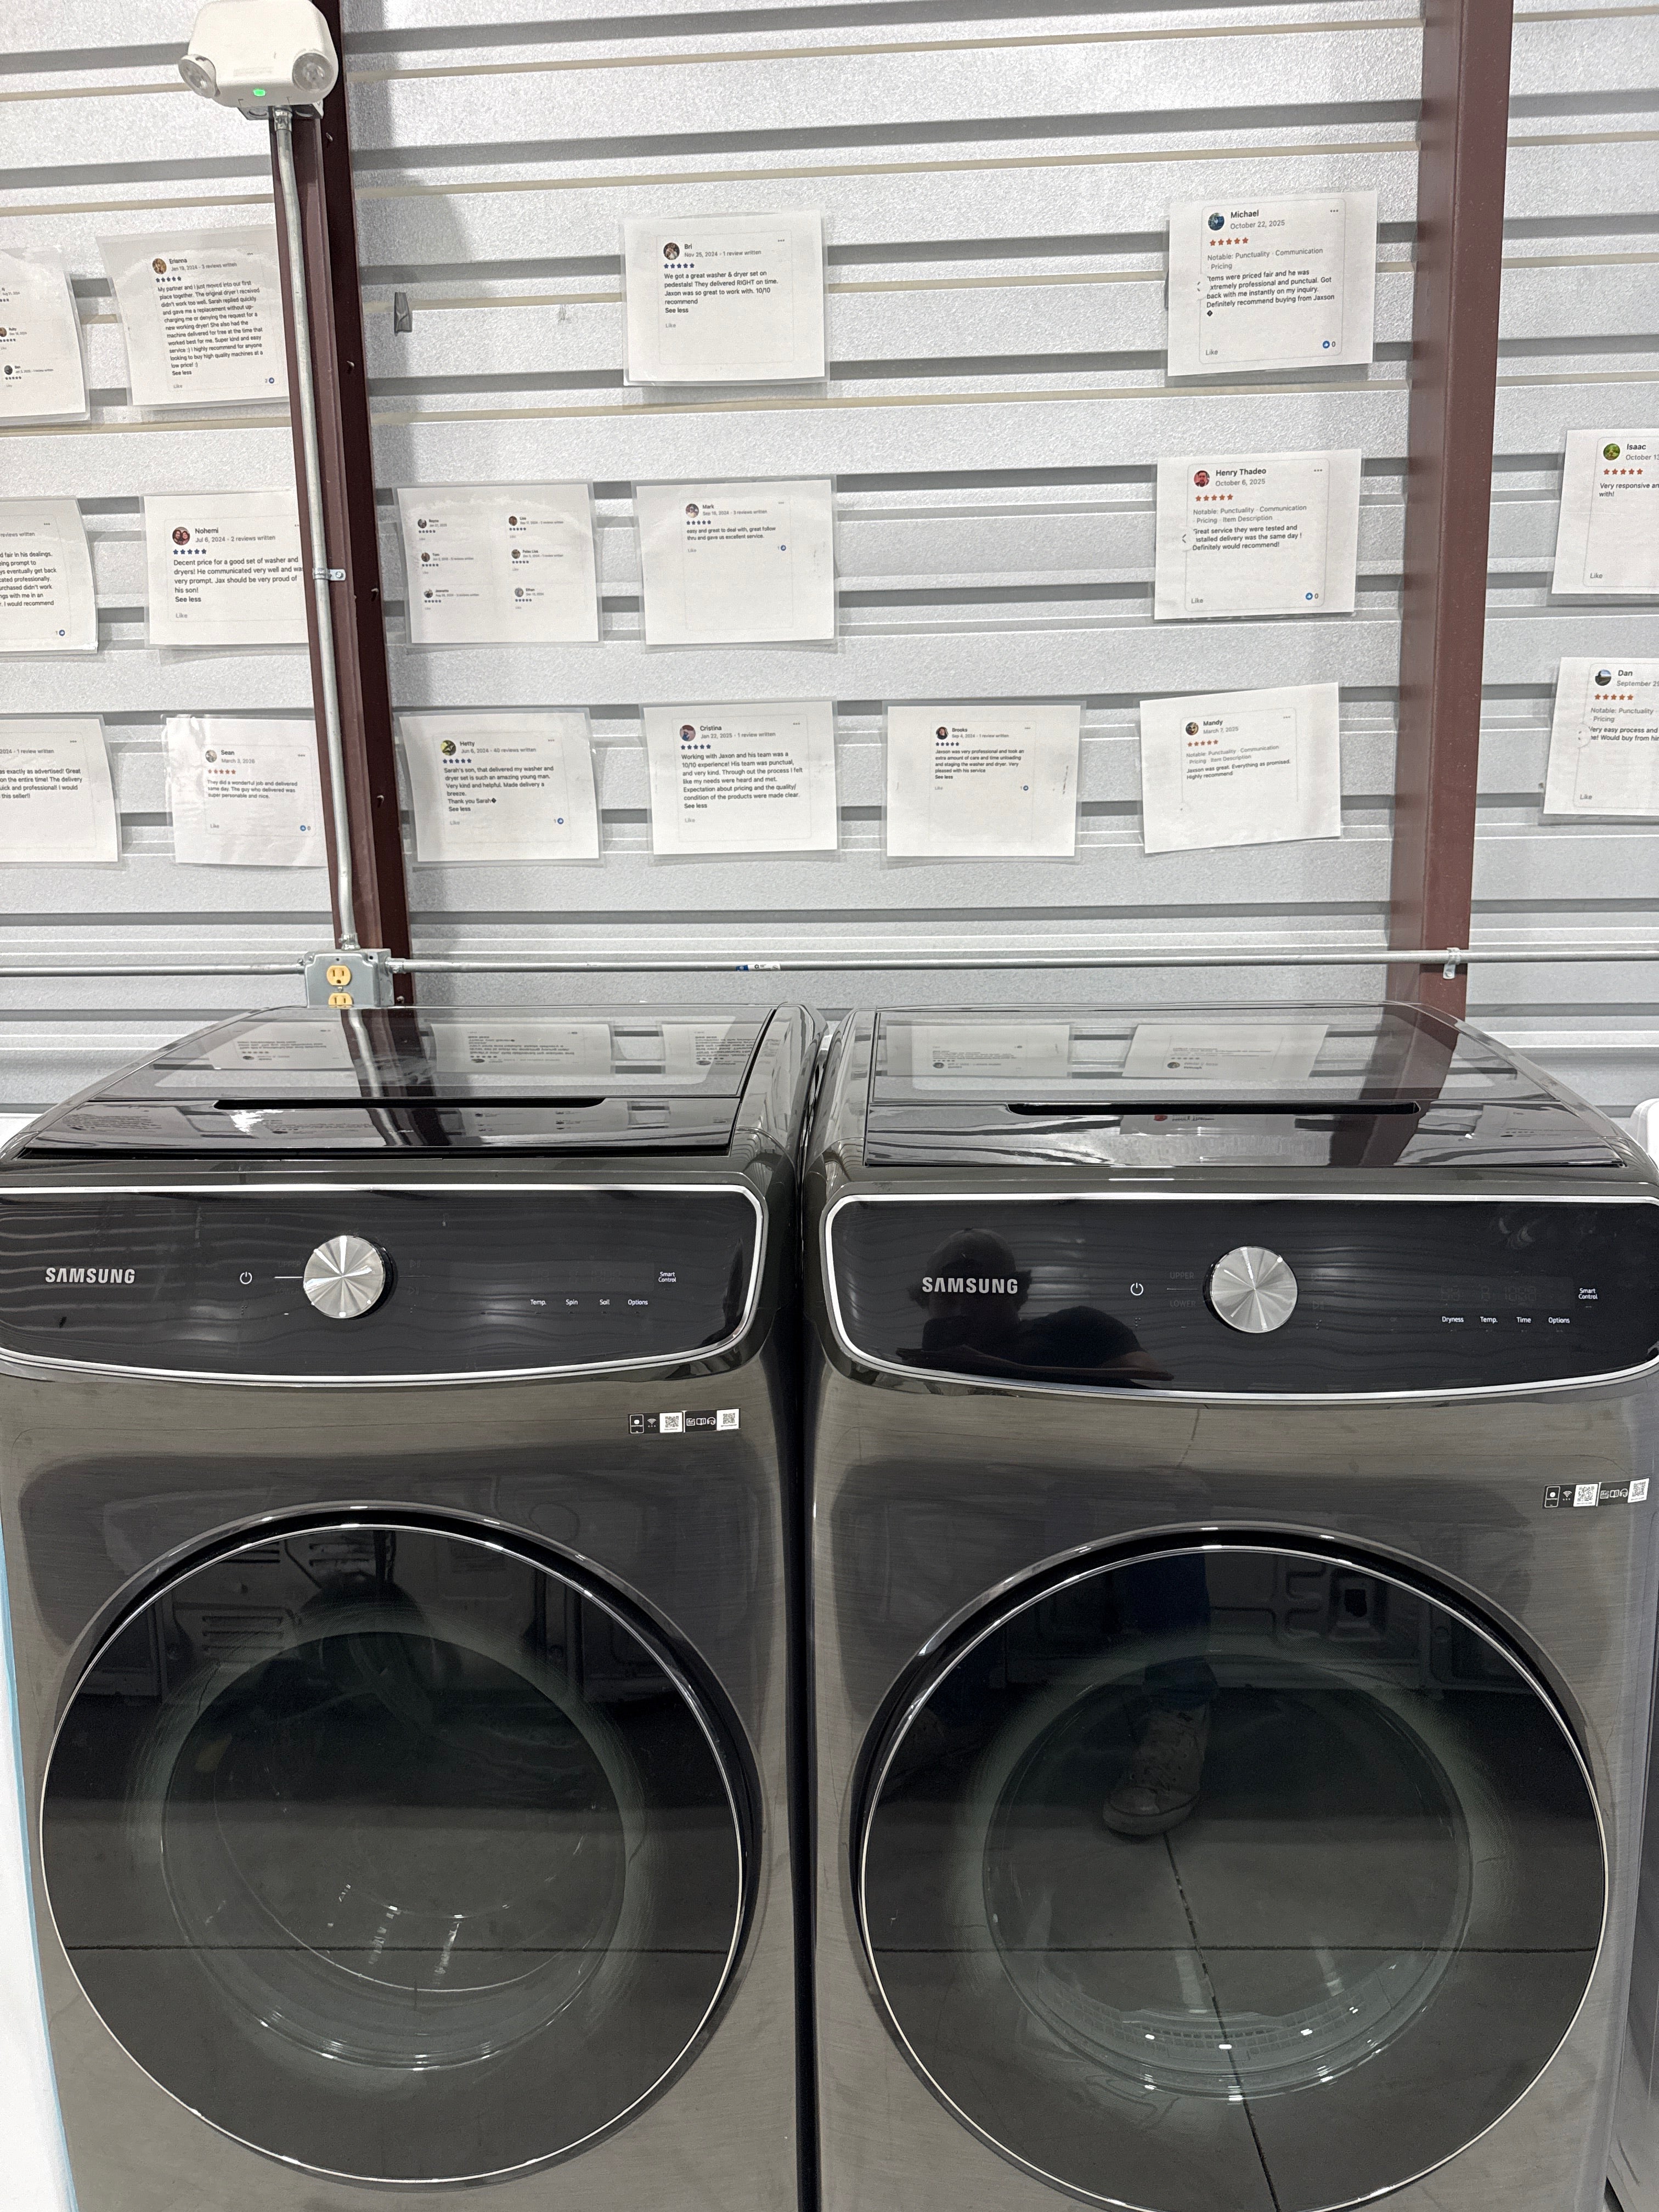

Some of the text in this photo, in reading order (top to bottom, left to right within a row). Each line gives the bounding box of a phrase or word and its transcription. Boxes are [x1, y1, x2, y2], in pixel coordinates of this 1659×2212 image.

[1231, 210, 1259, 218] Michael
[1235, 251, 1270, 259] Punctuality
[1275, 247, 1323, 256] Communication
[1206, 300, 1236, 308] Definitely
[1237, 297, 1274, 306] recommend
[229, 558, 245, 566] good
[45, 1267, 135, 1284] SAMSUNG
[1170, 1271, 1194, 1279] UPPER
[922, 1277, 1018, 1294] SAMSUNG
